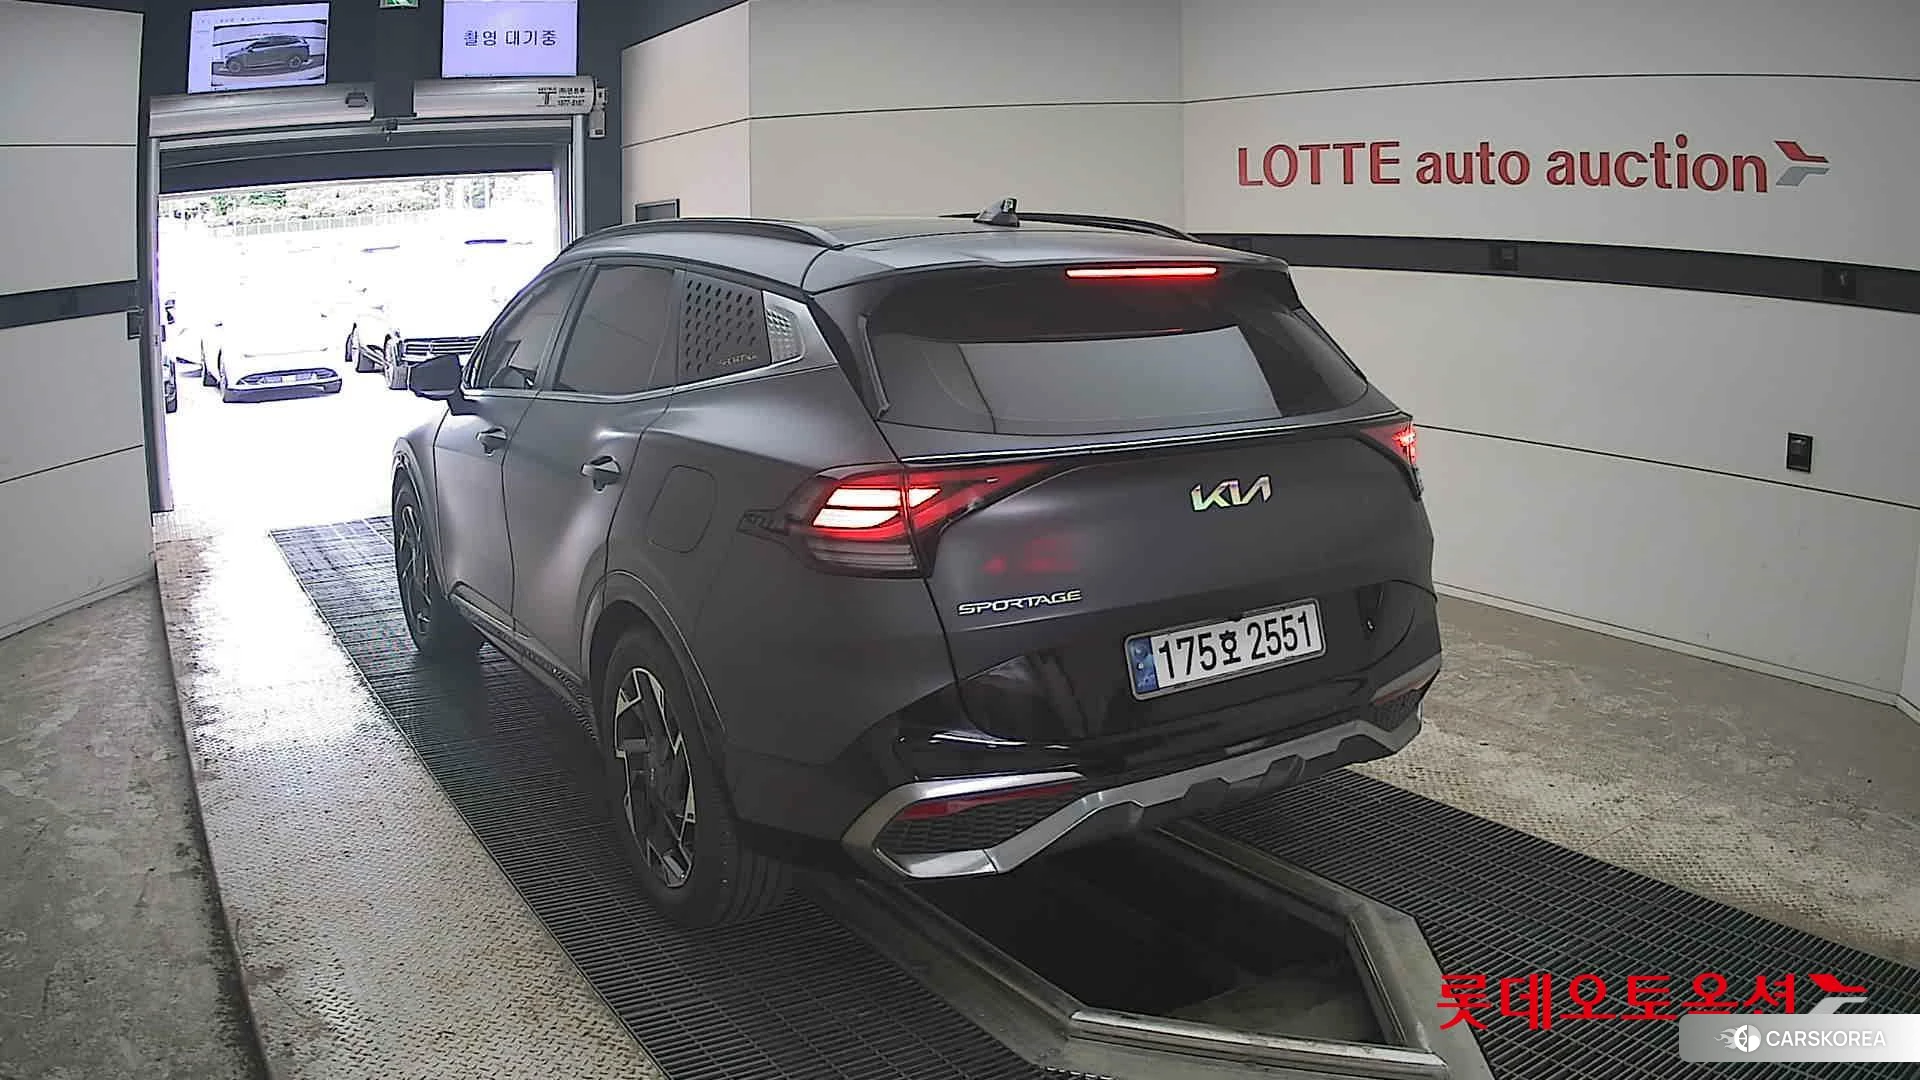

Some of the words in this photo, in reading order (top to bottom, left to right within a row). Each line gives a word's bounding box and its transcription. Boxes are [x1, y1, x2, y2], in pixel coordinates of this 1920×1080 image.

[463, 30, 497, 47] 촬영
[505, 30, 557, 46] 대기중
[1237, 141, 1401, 188] LOTTE
[1416, 142, 1530, 185] auto
[1546, 134, 1768, 193] auction
[1191, 476, 1272, 511] KIA
[958, 589, 1083, 616] SPORTAGE
[1158, 630, 1242, 680] 175호
[1246, 611, 1312, 661] 2551
